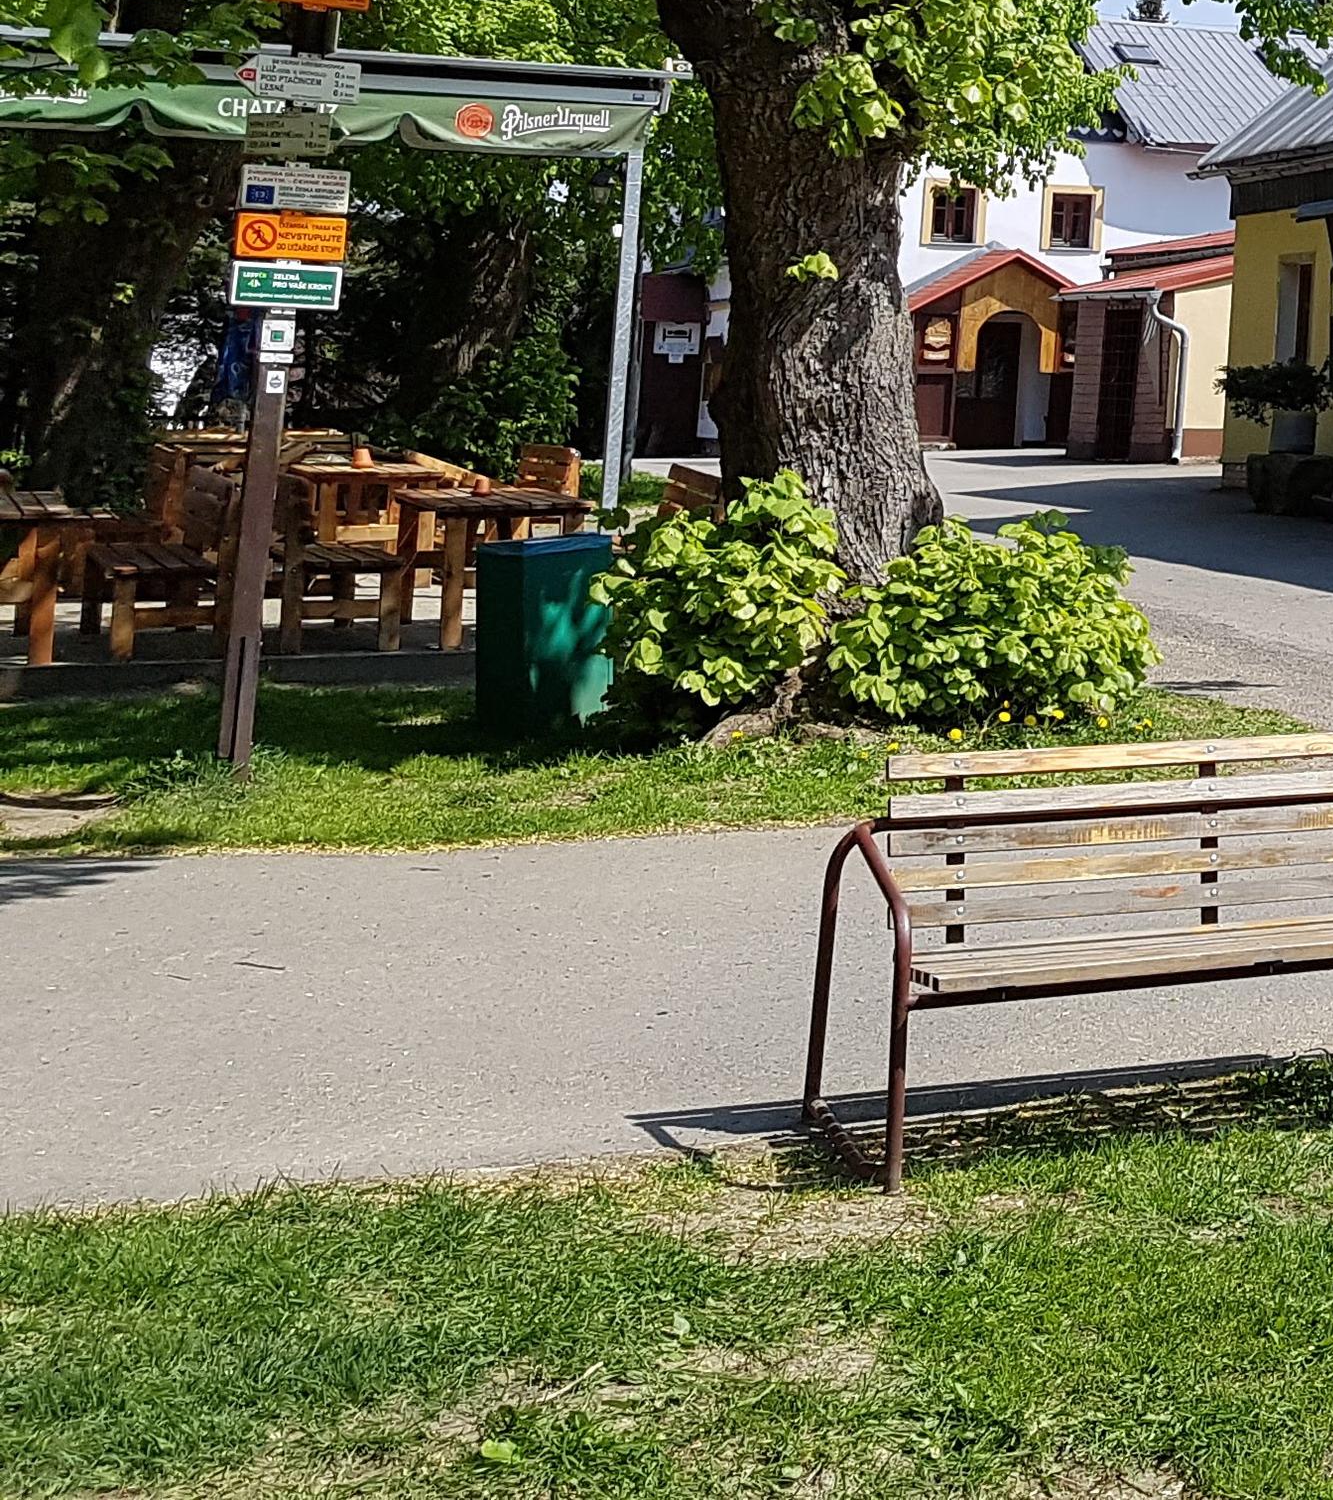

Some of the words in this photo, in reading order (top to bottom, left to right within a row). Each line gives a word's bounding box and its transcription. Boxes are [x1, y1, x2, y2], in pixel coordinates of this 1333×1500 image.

[501, 104, 555, 141] Pilsner
[557, 106, 610, 134] Urquell
[278, 232, 343, 243] NEVSTUPUJTE
